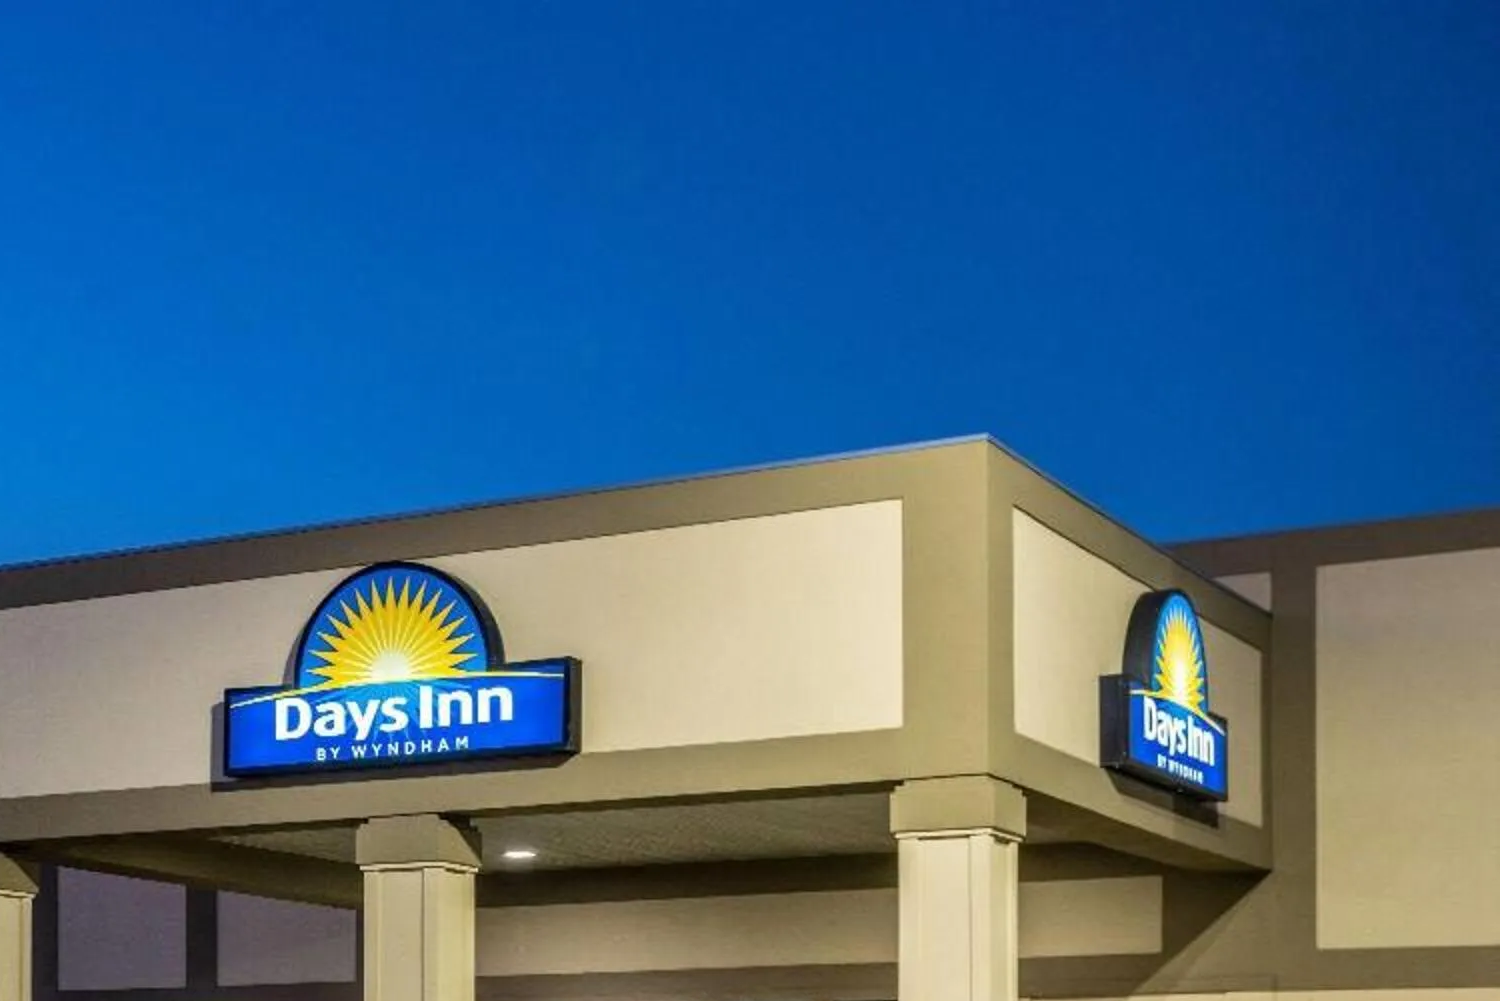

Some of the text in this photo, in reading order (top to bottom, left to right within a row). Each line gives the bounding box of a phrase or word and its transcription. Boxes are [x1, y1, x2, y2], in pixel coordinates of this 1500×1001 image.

[275, 685, 513, 741] Days Inn
[1144, 695, 1215, 767] Days Inn
[316, 735, 469, 761] BY WYNDHAM
